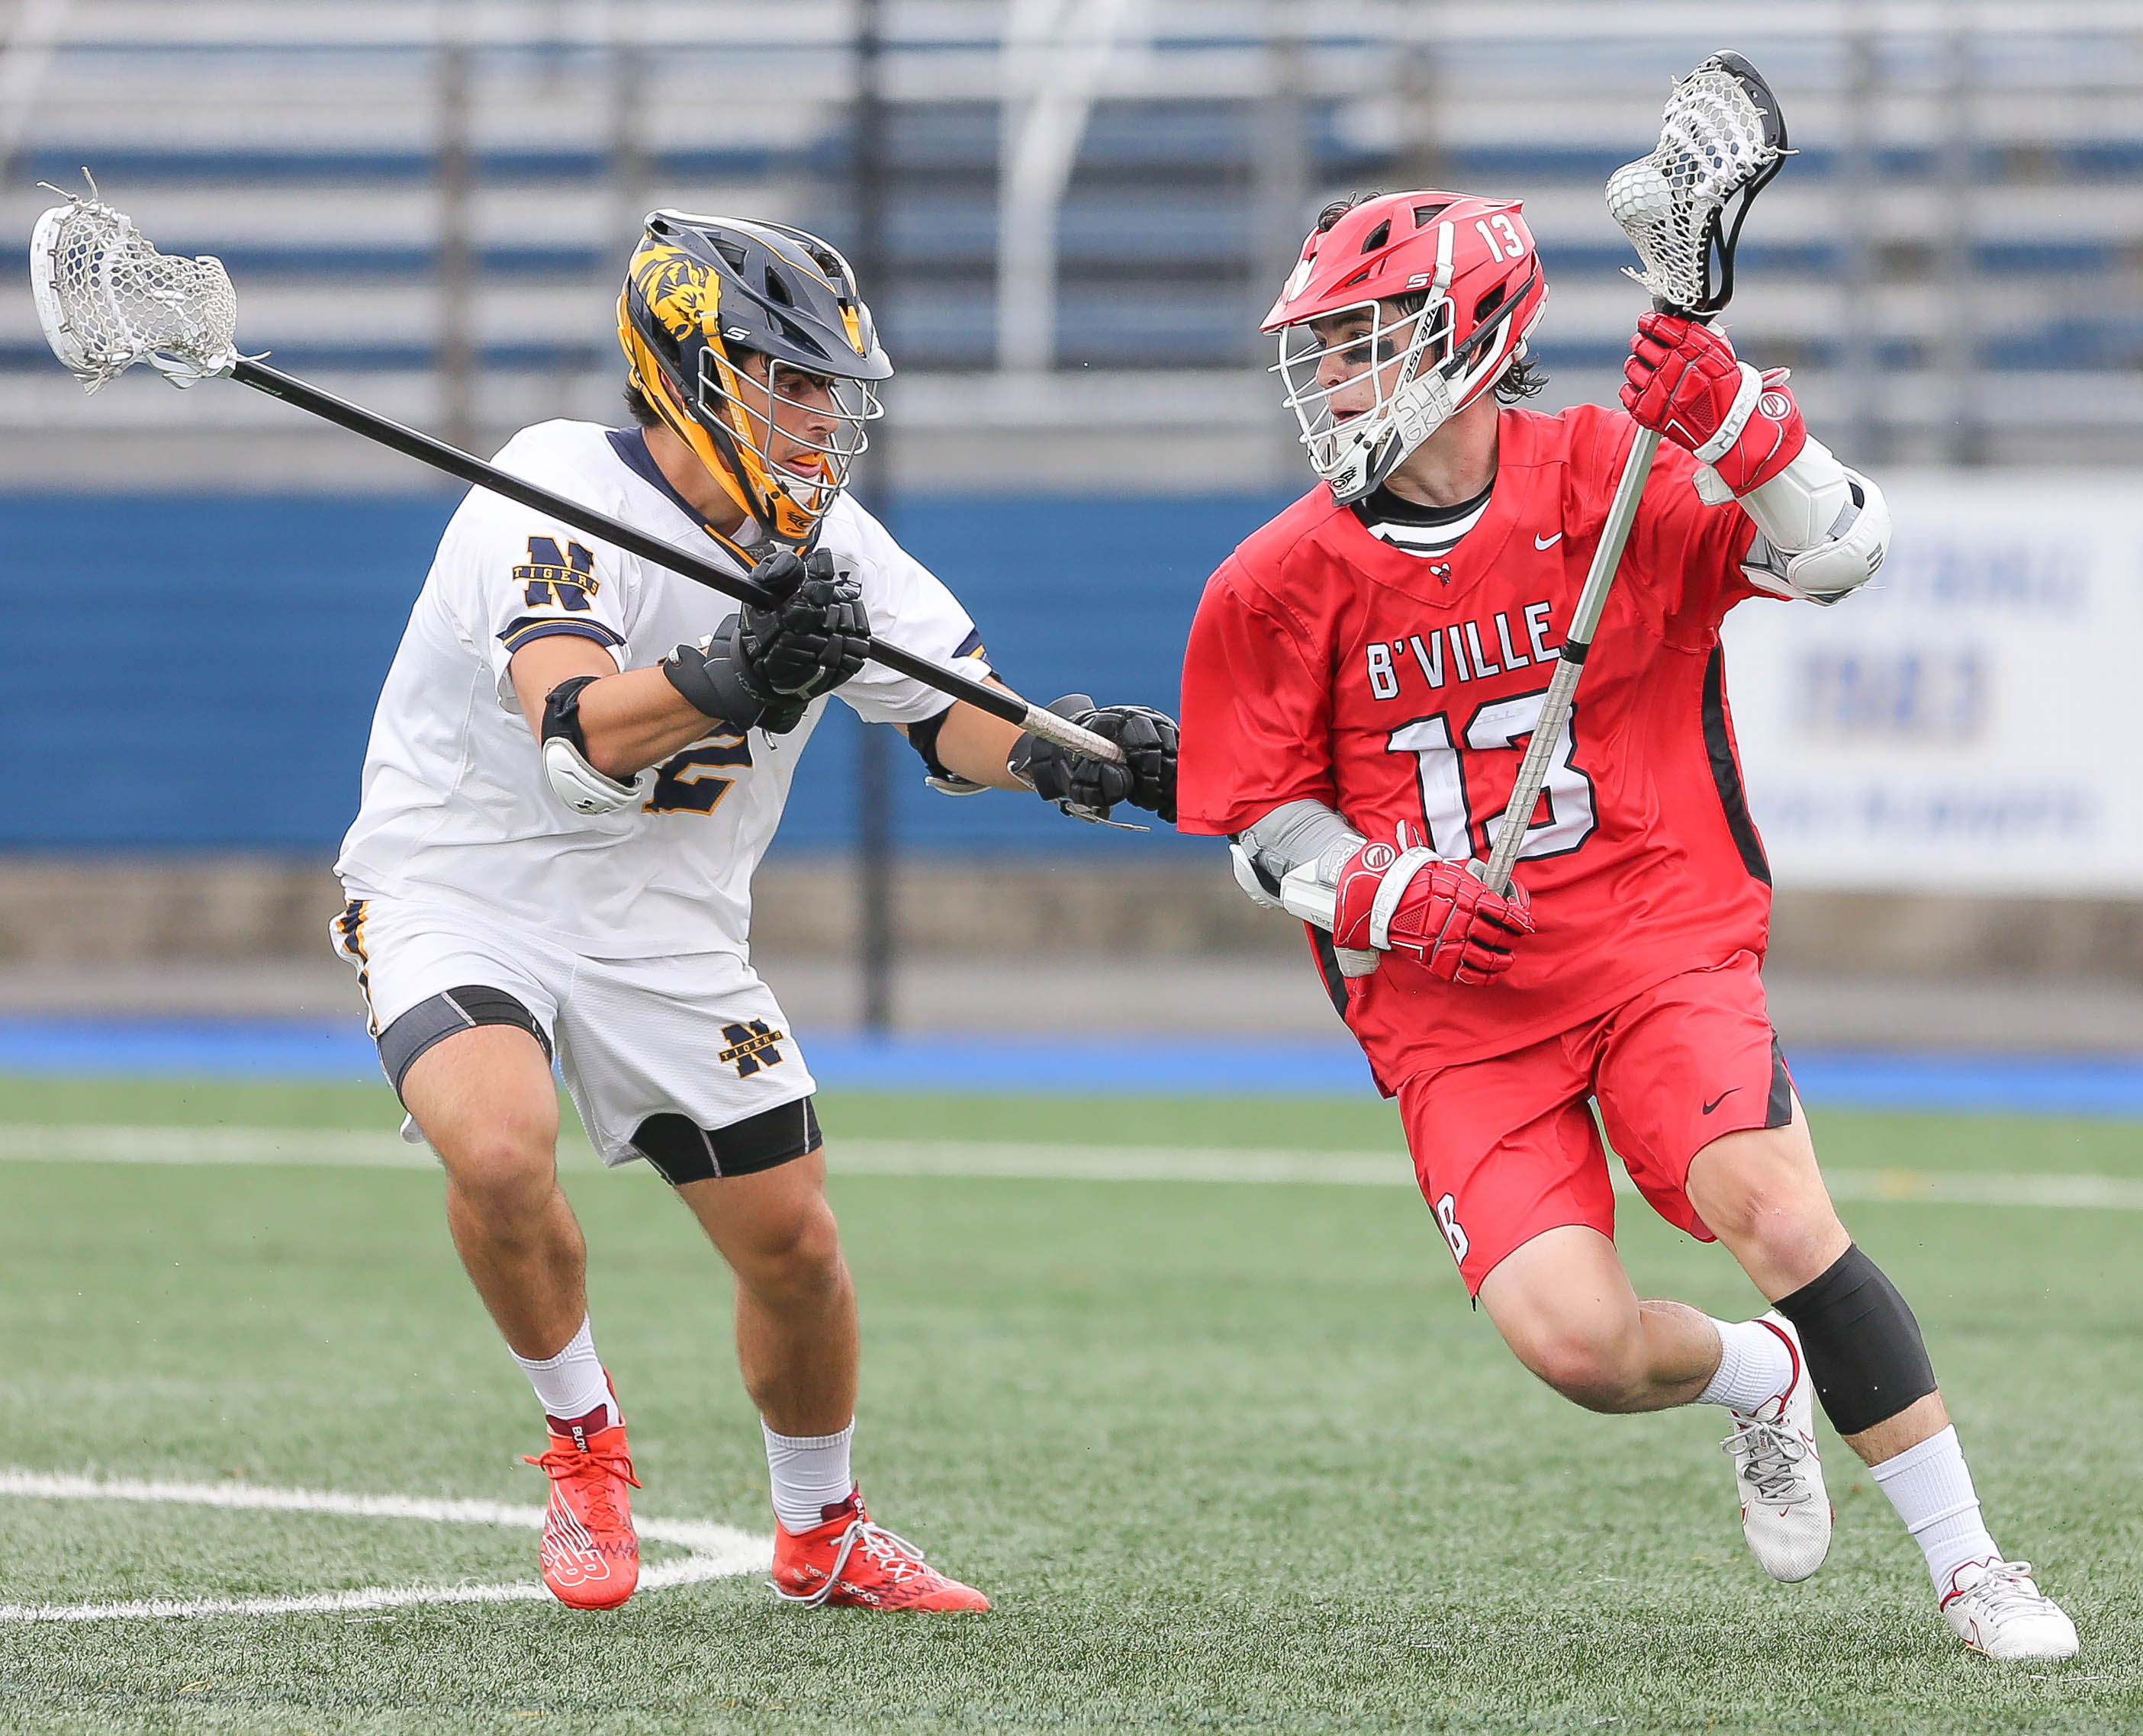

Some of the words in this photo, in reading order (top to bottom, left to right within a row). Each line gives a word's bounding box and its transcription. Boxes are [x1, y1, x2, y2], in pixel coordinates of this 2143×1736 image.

[1475, 214, 1525, 263] 13
[513, 567, 599, 594] TIGERS
[523, 535, 594, 612] N
[1366, 600, 1562, 699] B'VILLE
[1386, 687, 1598, 862] 13
[1328, 844, 1356, 883] EPOCH
[720, 1017, 784, 1079] N
[722, 1030, 781, 1060] TIGERS
[1437, 1192, 1469, 1266] B
[572, 1426, 588, 1453] BURN
